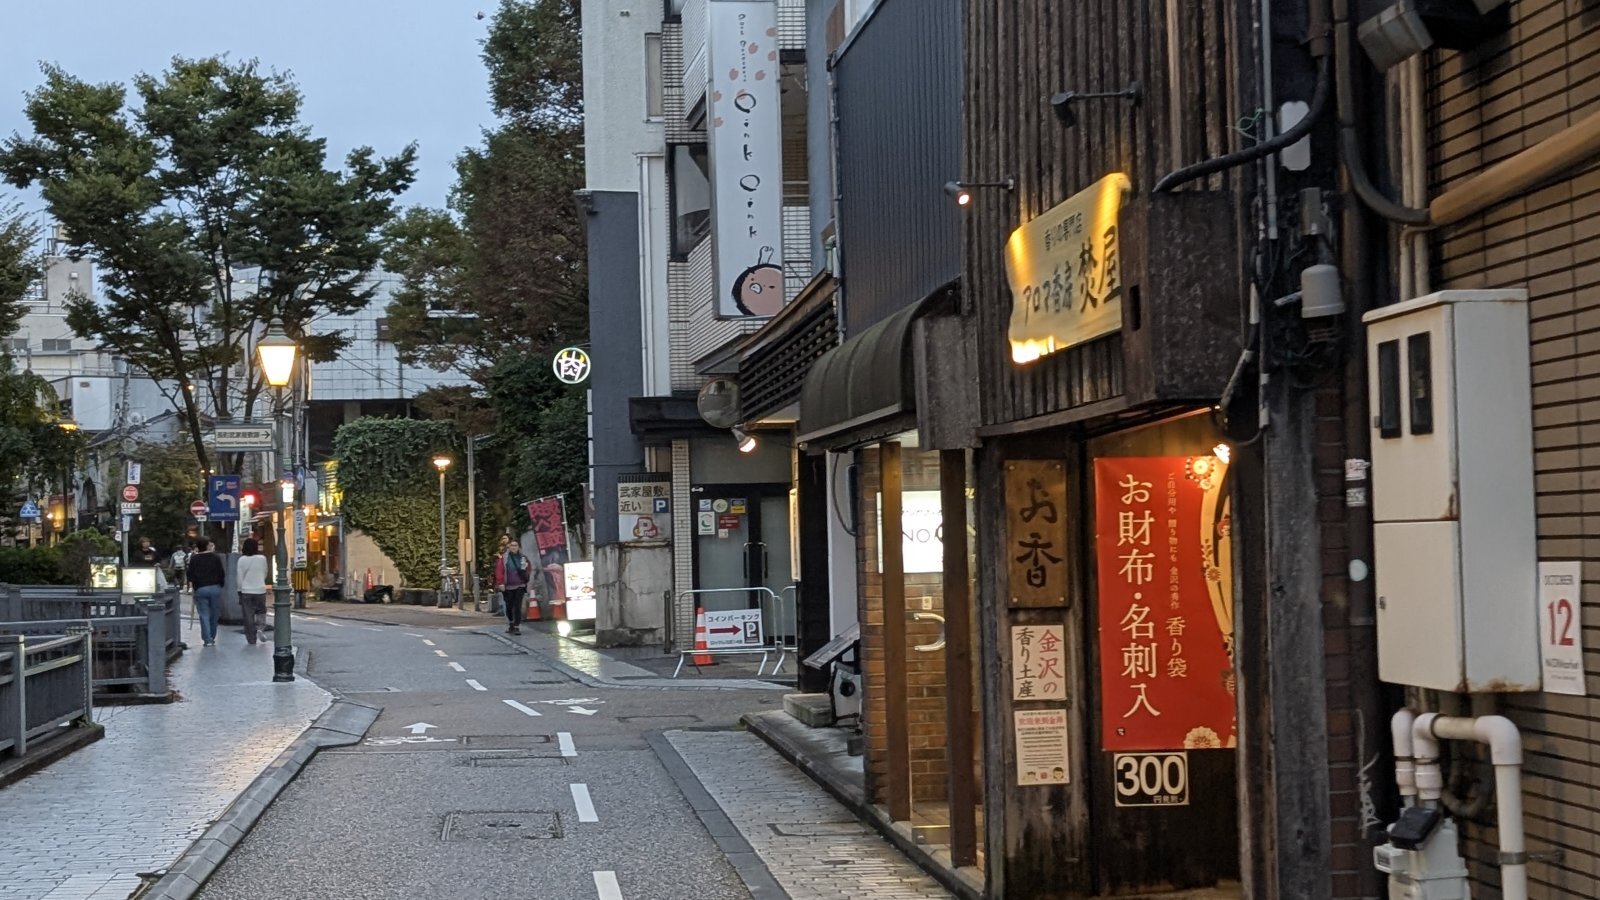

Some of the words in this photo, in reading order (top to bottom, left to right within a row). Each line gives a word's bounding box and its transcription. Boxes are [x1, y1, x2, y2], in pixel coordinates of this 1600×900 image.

[734, 93, 756, 161] Oink
[739, 174, 760, 238] Oink
[215, 480, 224, 491] P
[620, 501, 642, 512] 近い
[655, 500, 666, 512] P
[1016, 476, 1063, 589] お香
[708, 614, 760, 623] コインパーキング
[1117, 473, 1161, 719] お財布・名刺入
[1547, 598, 1574, 647] 12
[745, 622, 757, 638] P
[1165, 616, 1187, 678] 香り袋
[1015, 626, 1036, 698] 香り土産
[1037, 628, 1063, 694] 金沢の
[1117, 755, 1185, 797] 300
